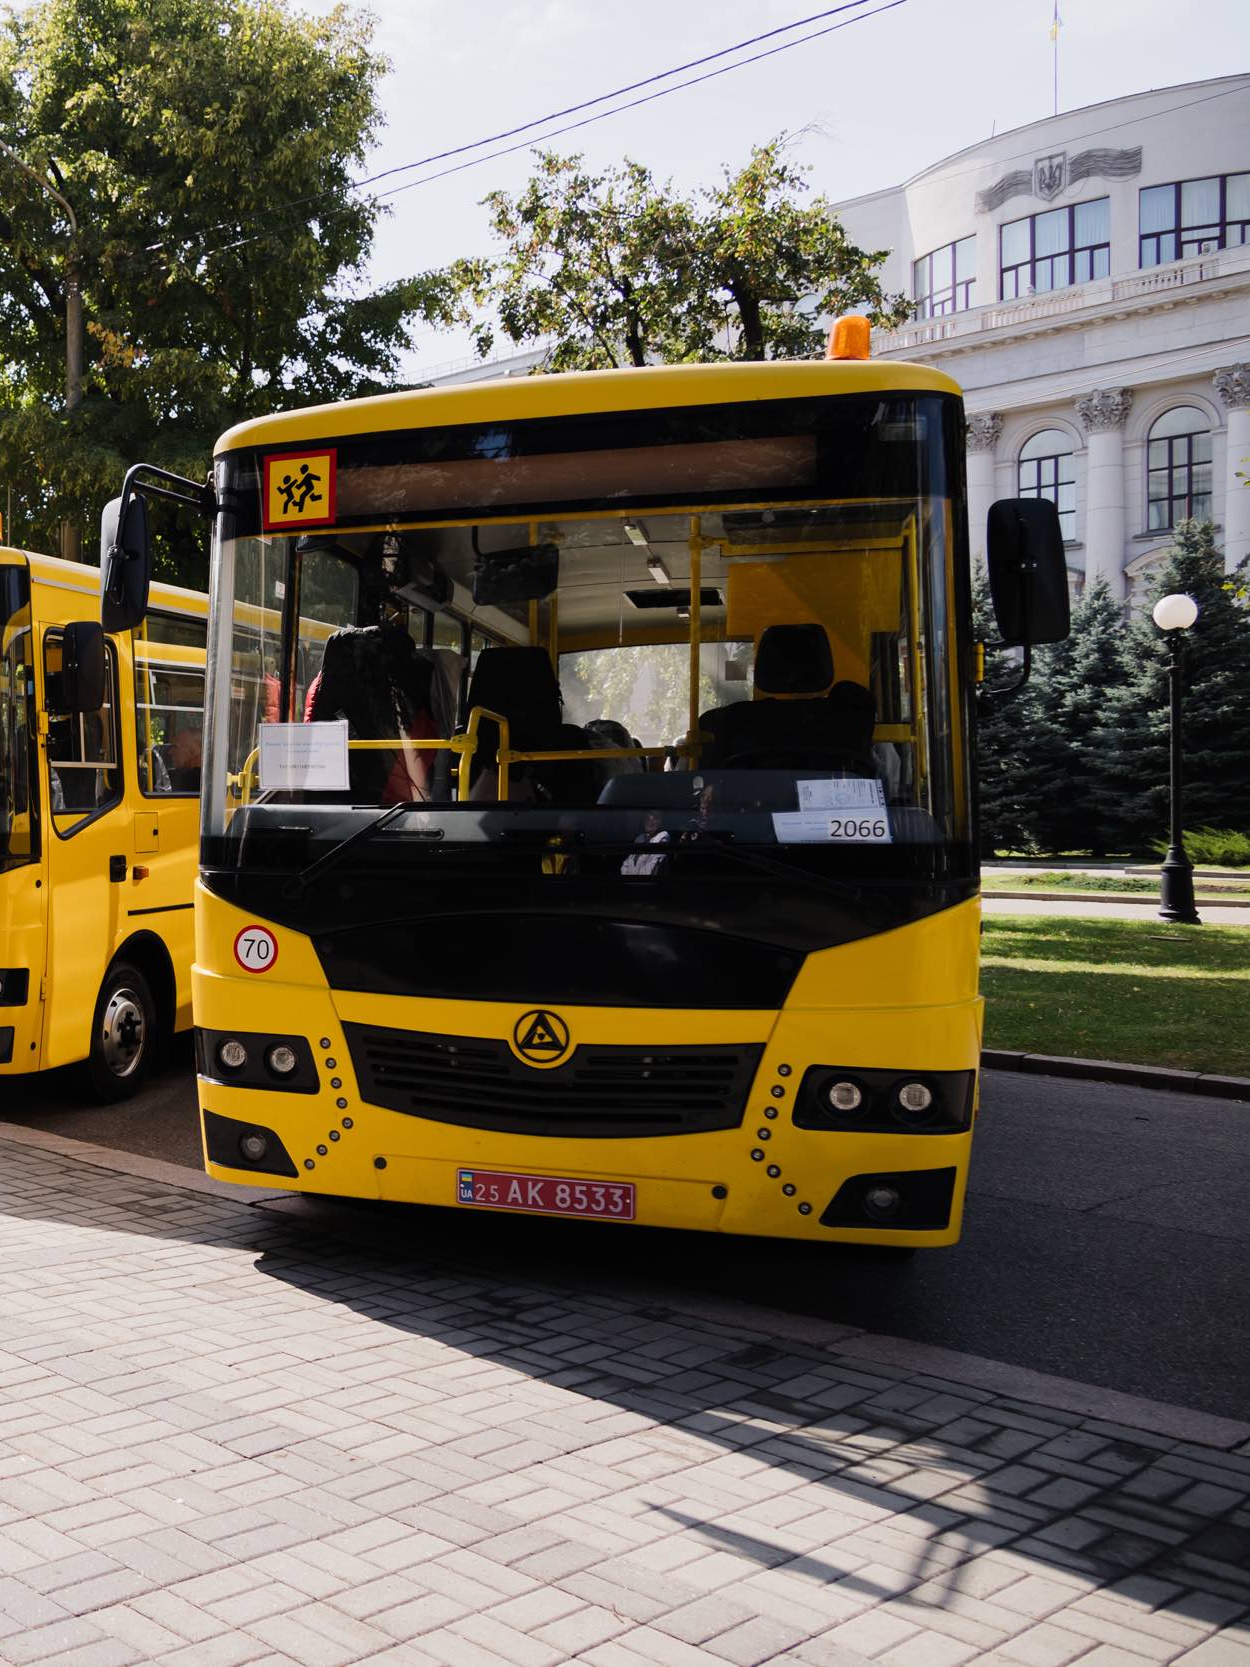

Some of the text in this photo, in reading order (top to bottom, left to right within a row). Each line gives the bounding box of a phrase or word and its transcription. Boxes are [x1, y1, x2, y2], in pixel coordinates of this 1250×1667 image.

[830, 820, 885, 837] 2066
[243, 938, 270, 960] 70
[461, 1179, 623, 1213] UA 25 AK 8533
